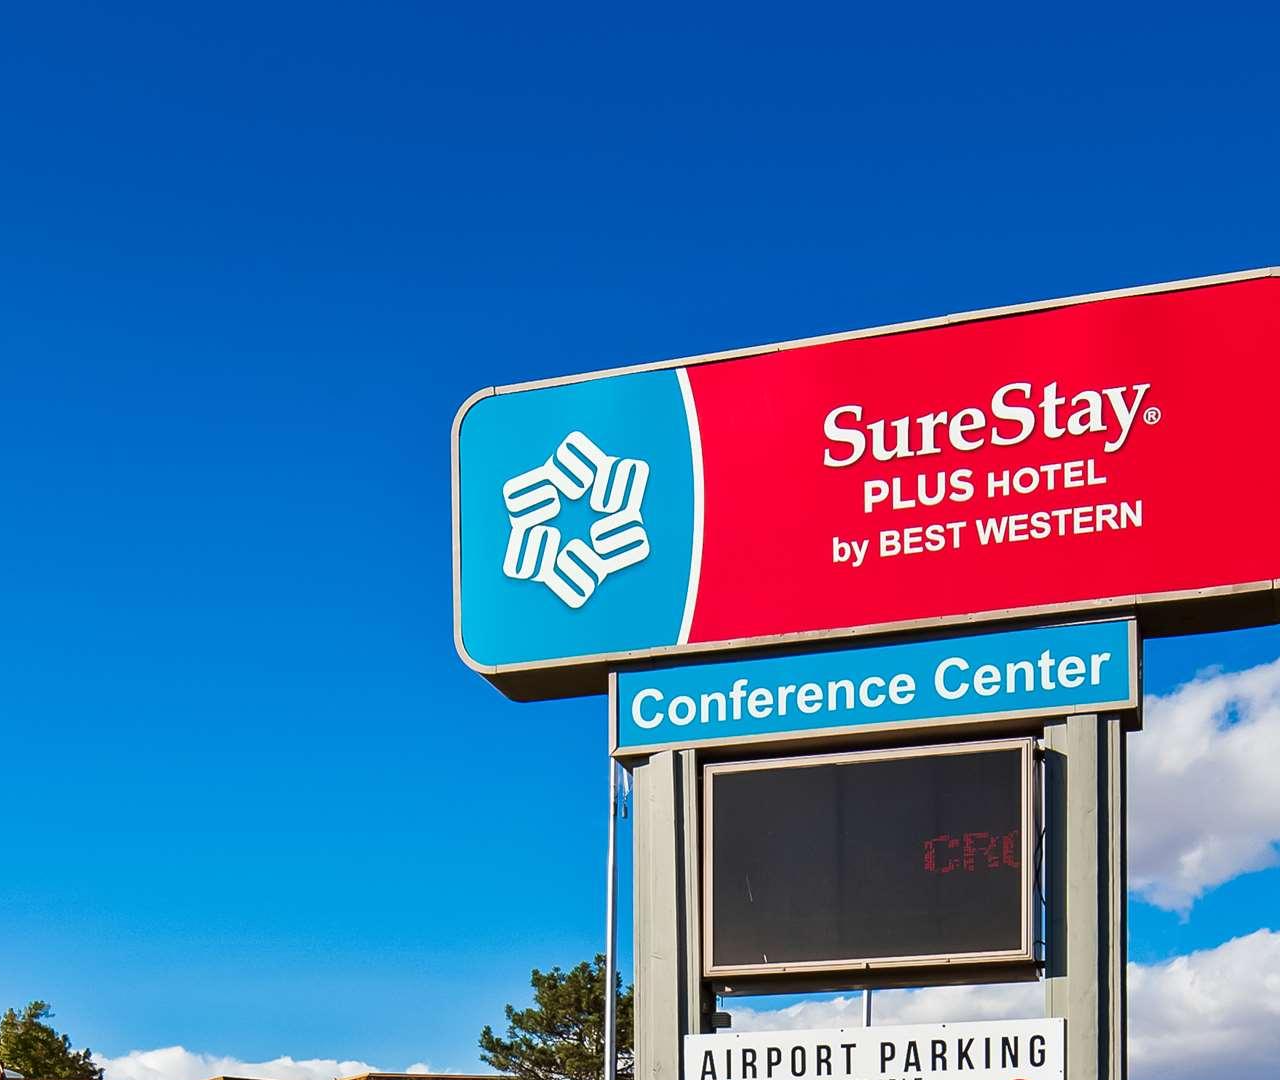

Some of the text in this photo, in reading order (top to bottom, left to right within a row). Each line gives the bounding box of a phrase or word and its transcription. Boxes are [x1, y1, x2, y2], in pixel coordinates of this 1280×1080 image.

[864, 458, 1107, 514] PLUS HOTEL
[832, 500, 1144, 568] by BEST WESTERN
[631, 648, 1112, 729] Conference Center
[700, 1034, 1047, 1080] AIRPORT PARKING
